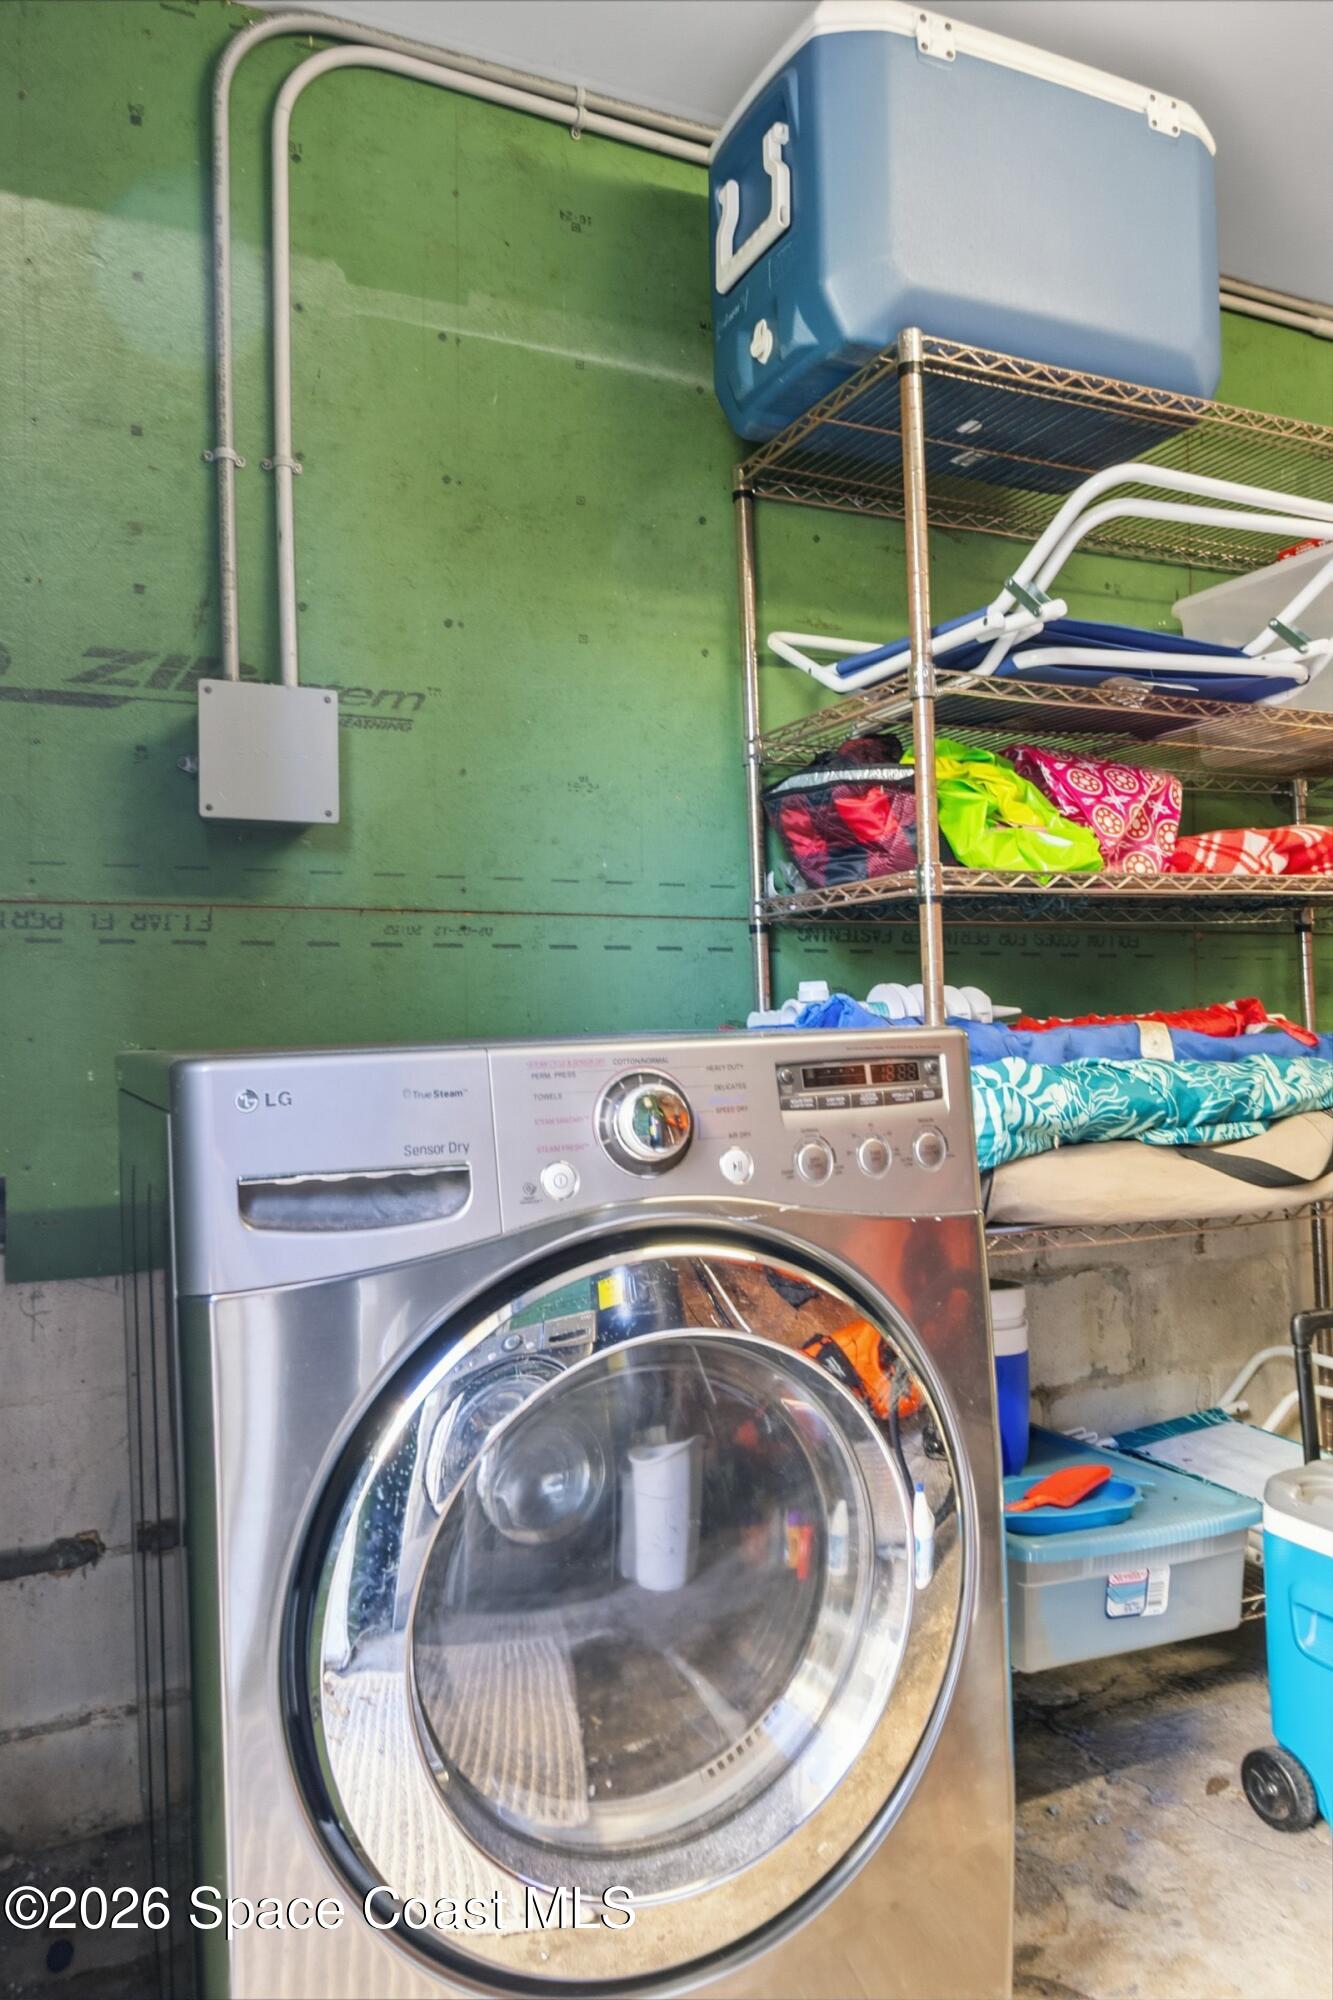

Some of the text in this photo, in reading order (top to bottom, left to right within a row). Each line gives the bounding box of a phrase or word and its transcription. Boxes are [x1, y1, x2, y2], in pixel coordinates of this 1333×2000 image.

[264, 1091, 292, 1107] LG
[403, 1141, 470, 1158] Sensor Dry
